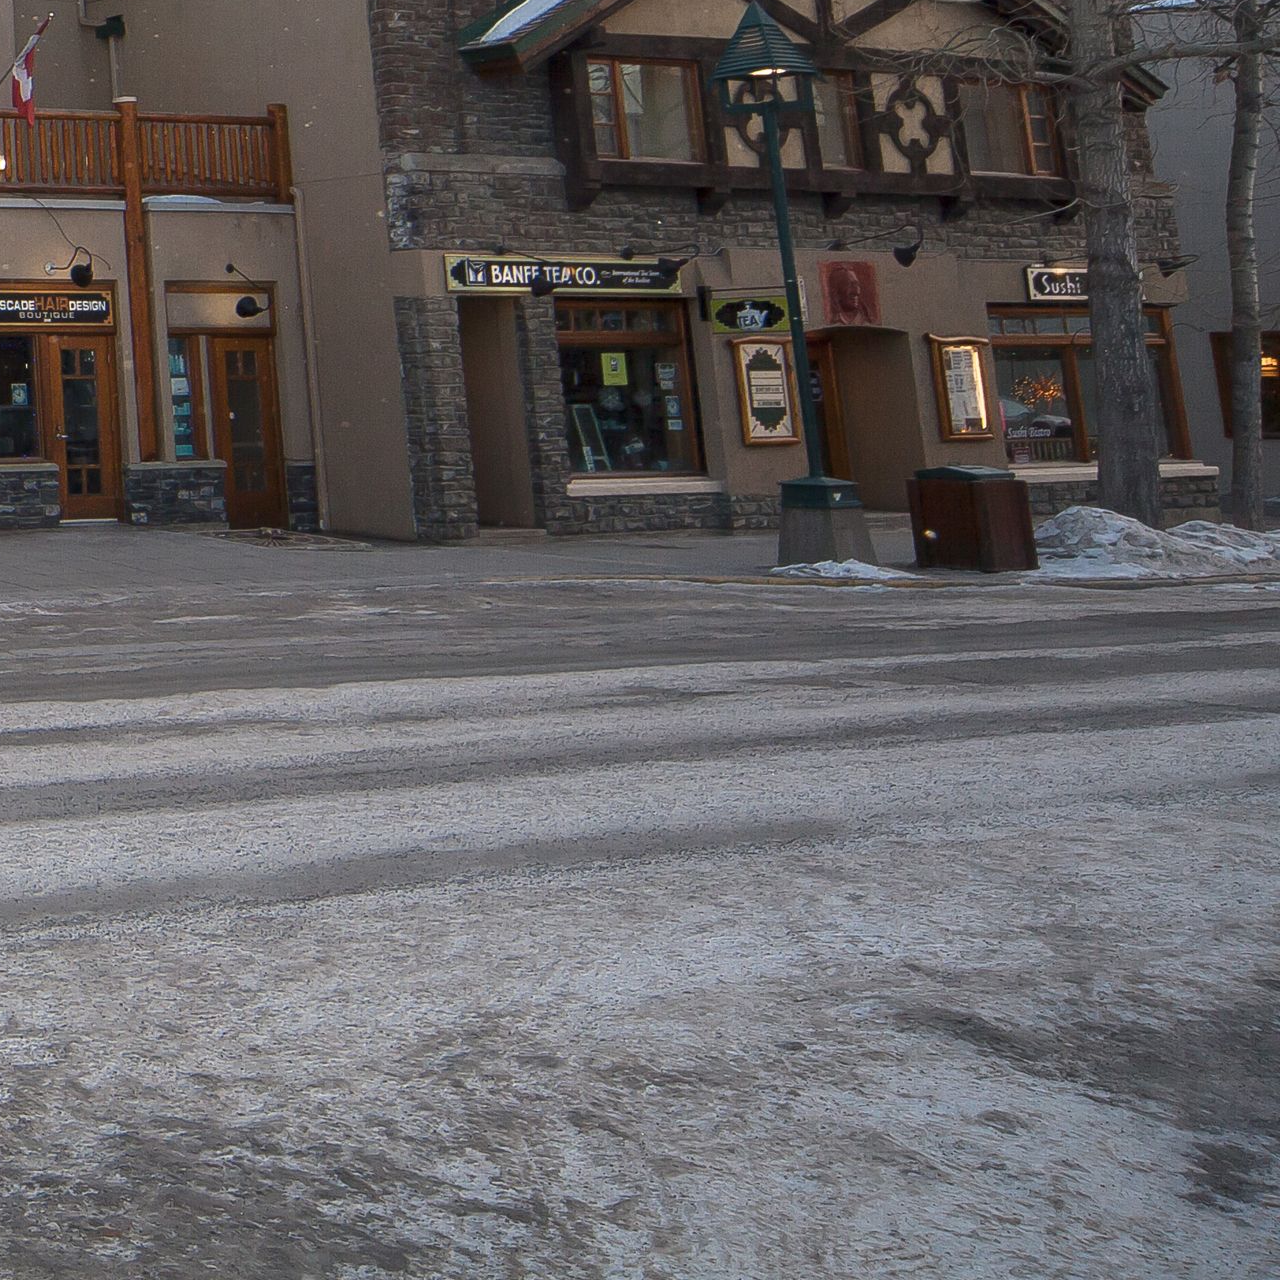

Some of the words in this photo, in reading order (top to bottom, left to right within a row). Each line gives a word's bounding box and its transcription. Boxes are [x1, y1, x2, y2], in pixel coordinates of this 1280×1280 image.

[491, 264, 539, 283] BANFF
[575, 267, 600, 284] CO.
[1042, 274, 1081, 294] Sushi
[19, 311, 75, 319] BOUTIQUE
[1007, 425, 1027, 439] Sushi
